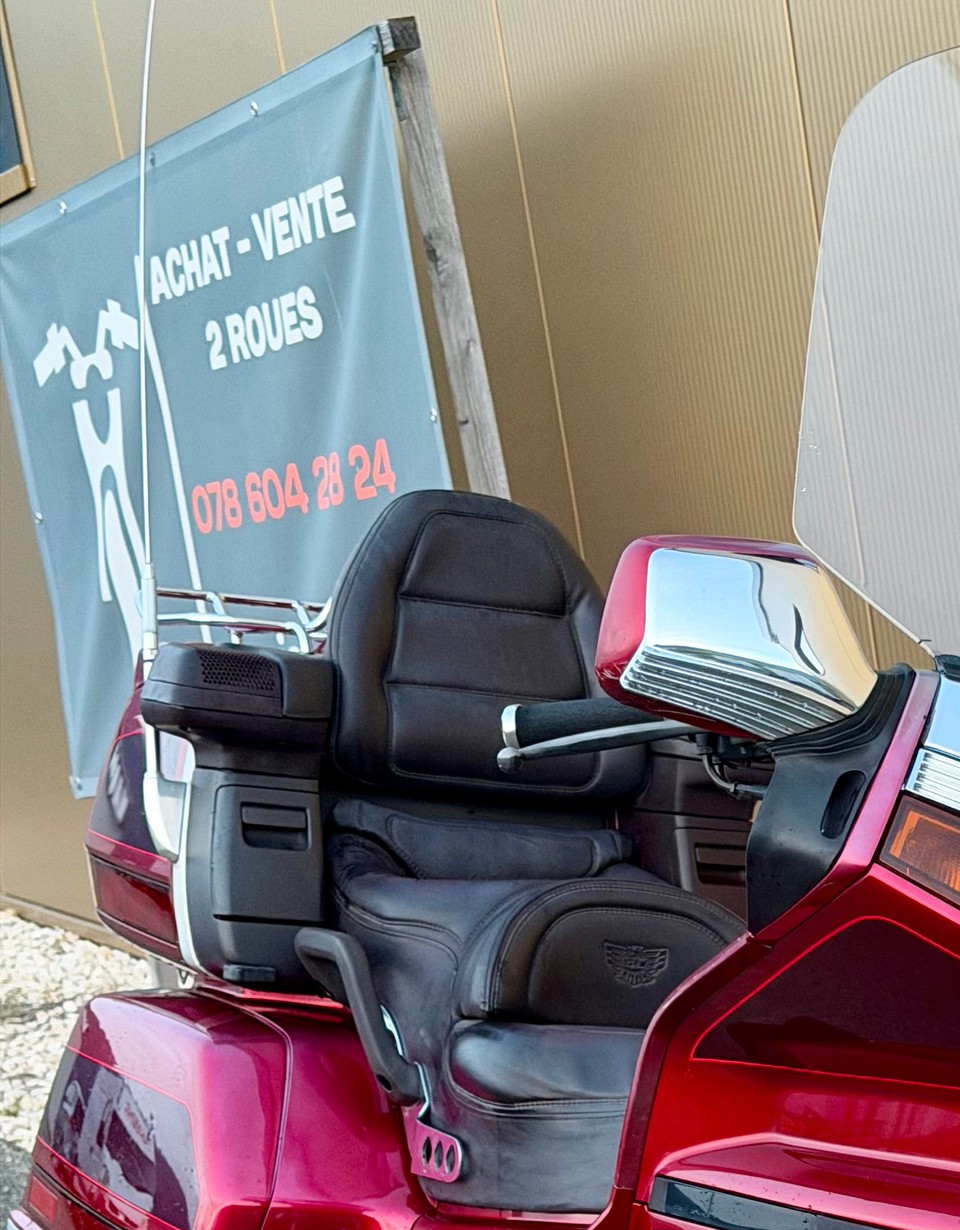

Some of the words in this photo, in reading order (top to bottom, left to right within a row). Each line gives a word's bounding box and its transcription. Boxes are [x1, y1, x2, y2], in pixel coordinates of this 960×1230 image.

[150, 226, 232, 305] ACHAT
[236, 238, 251, 254] -
[251, 176, 356, 261] VENTE
[205, 320, 227, 370] 2
[225, 285, 323, 363] ROUES
[192, 478, 243, 534] 078
[245, 463, 309, 523] 604
[312, 451, 344, 510] 28
[348, 438, 396, 500] 24
